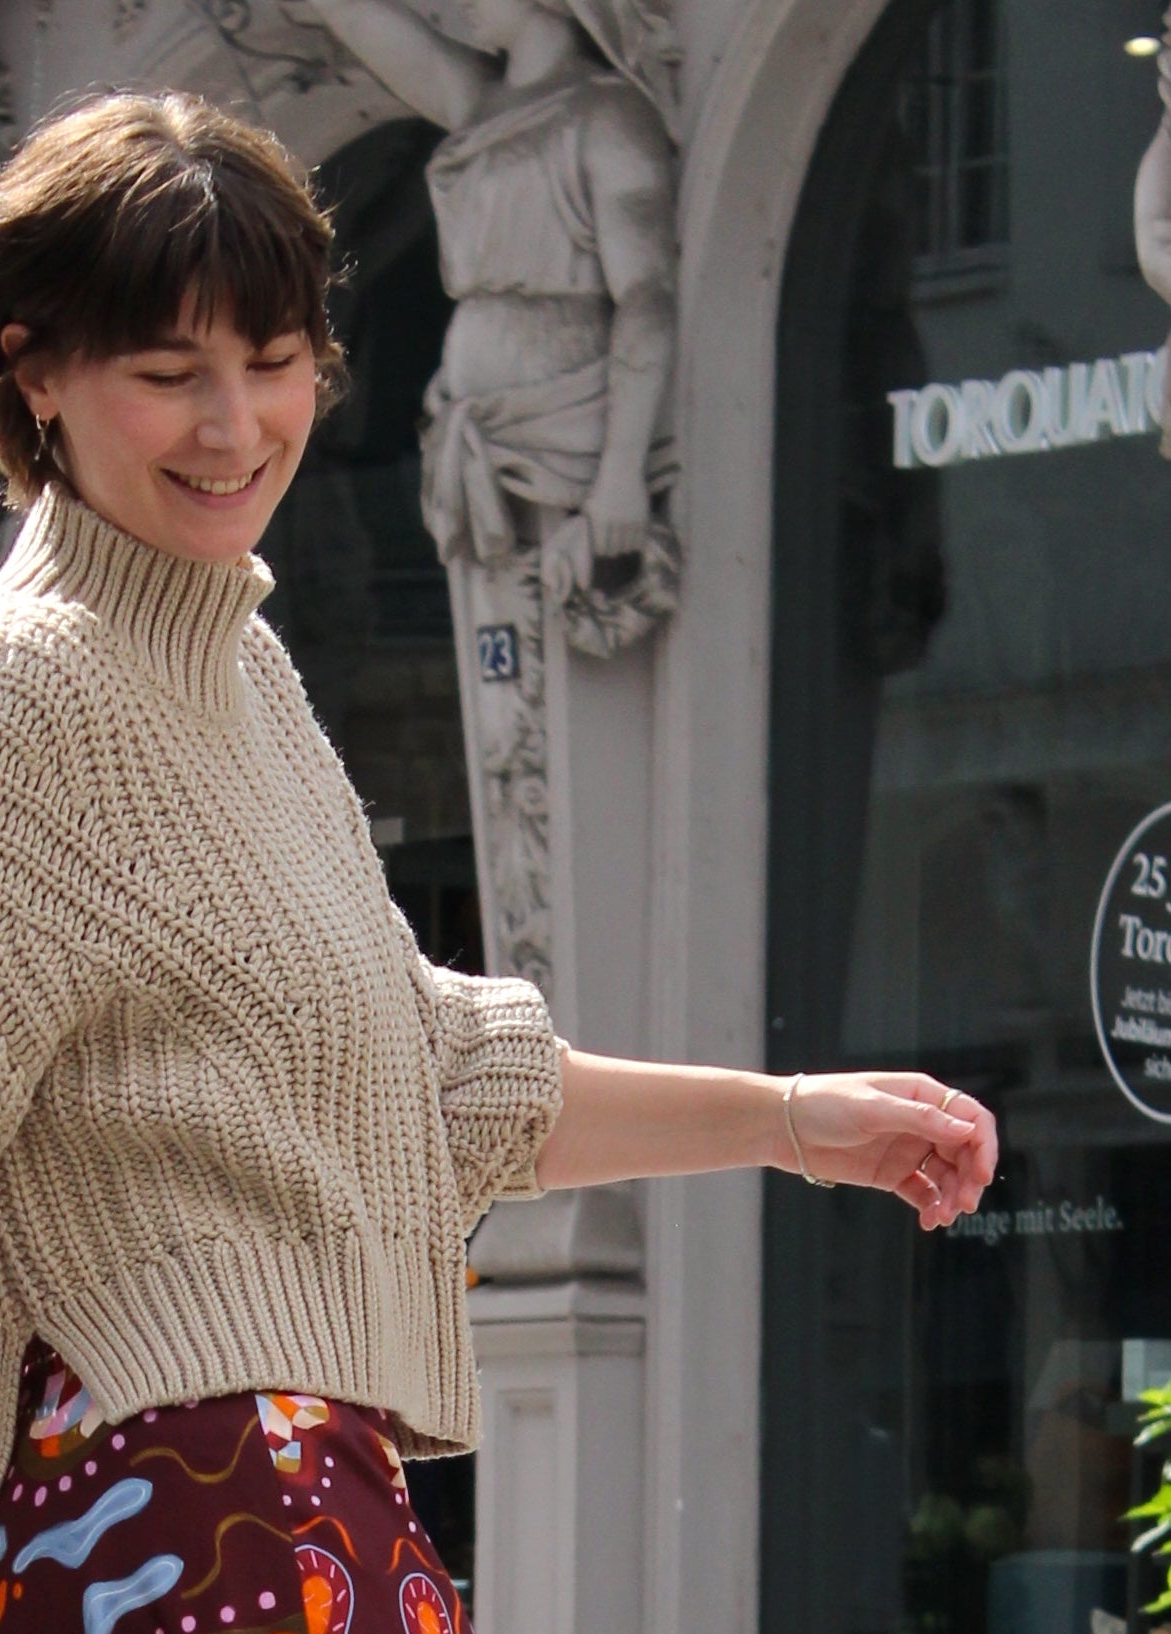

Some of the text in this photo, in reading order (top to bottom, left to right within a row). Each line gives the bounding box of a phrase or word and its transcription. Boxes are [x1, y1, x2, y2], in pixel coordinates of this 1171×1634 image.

[477, 630, 513, 678] 23
[1131, 853, 1167, 898] 25
[1014, 1200, 1055, 1234] mit
